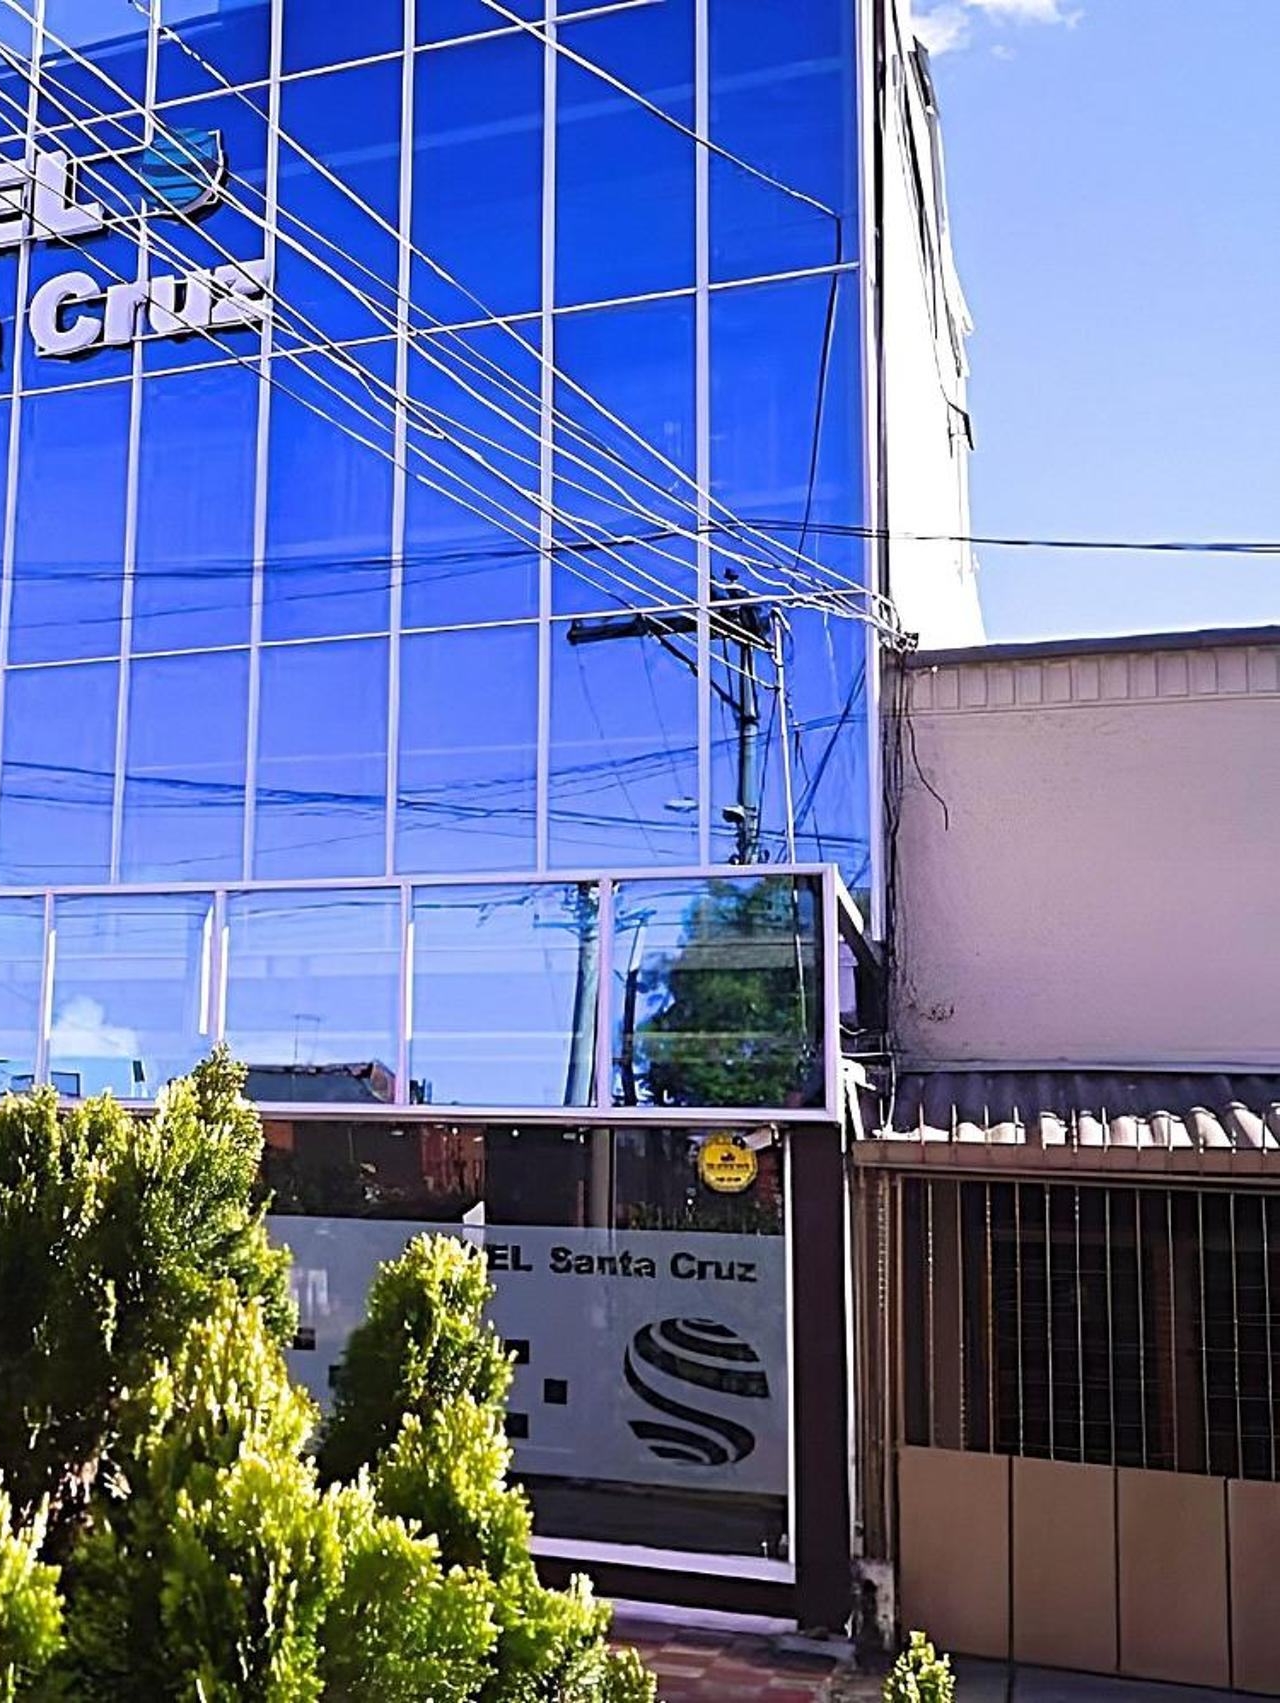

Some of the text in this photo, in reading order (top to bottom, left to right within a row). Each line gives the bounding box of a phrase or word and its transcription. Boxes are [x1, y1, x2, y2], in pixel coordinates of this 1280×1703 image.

[29, 258, 272, 357] Cruz
[549, 1246, 656, 1279] Santa
[670, 1252, 758, 1283] Cruz
